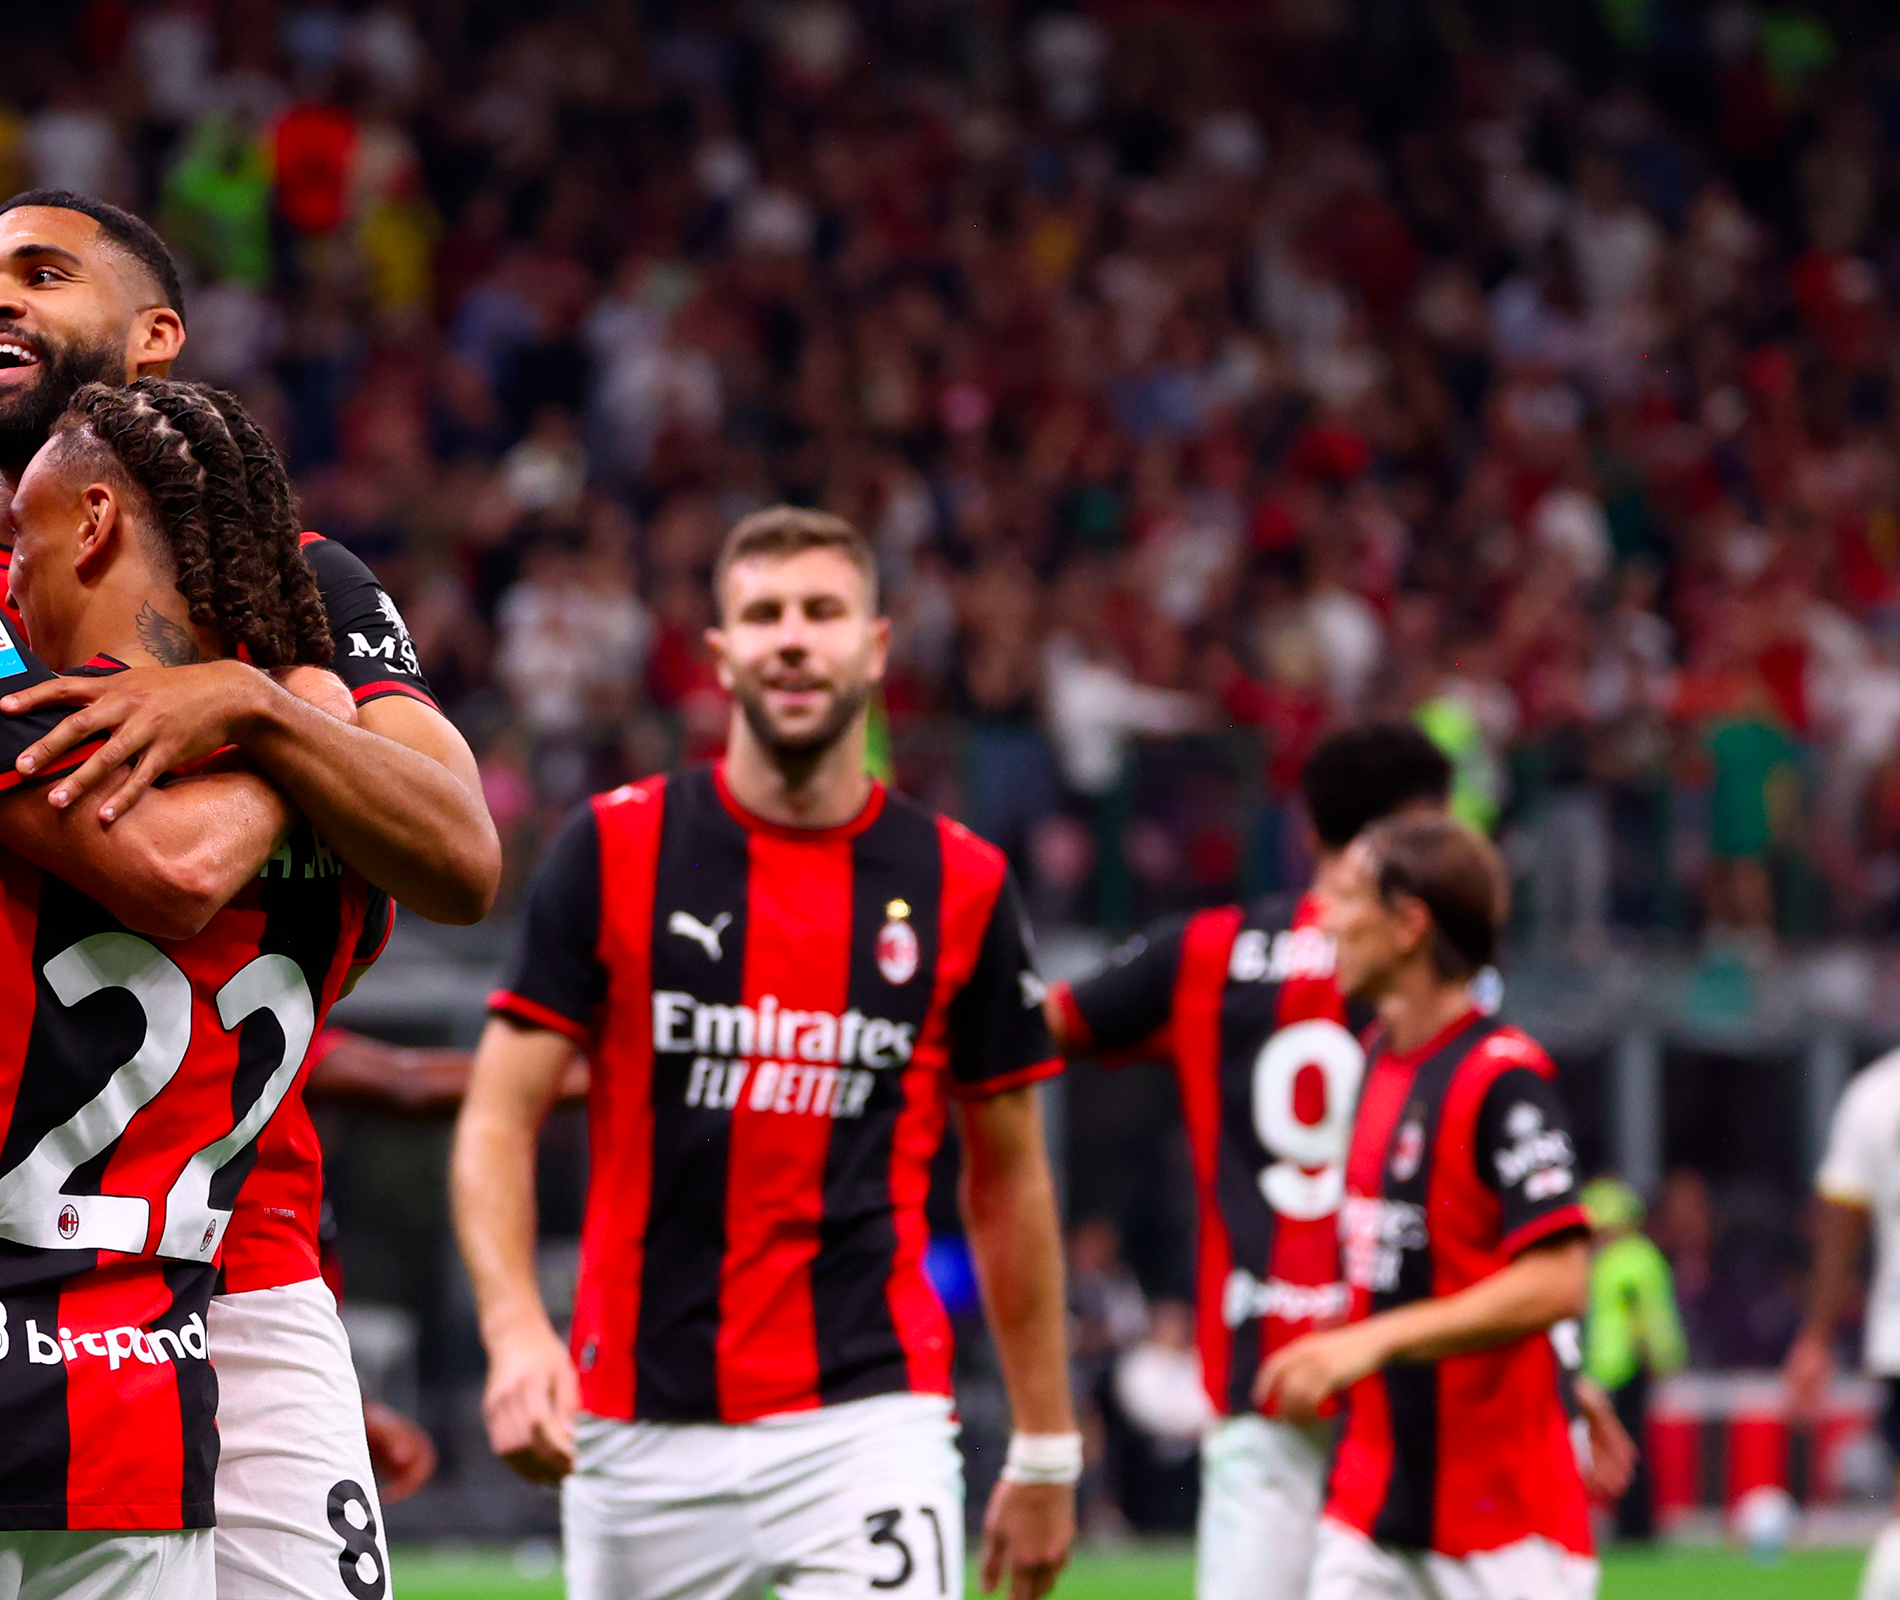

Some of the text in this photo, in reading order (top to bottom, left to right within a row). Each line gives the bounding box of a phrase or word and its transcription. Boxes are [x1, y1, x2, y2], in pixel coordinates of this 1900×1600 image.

[652, 989, 916, 1070] Emirates
[684, 1056, 876, 1120] FLY BETTER
[1252, 1017, 1367, 1222] 9
[25, 1311, 211, 1371] bitpand
[326, 1479, 386, 1600] 8
[865, 1506, 946, 1595] 31
